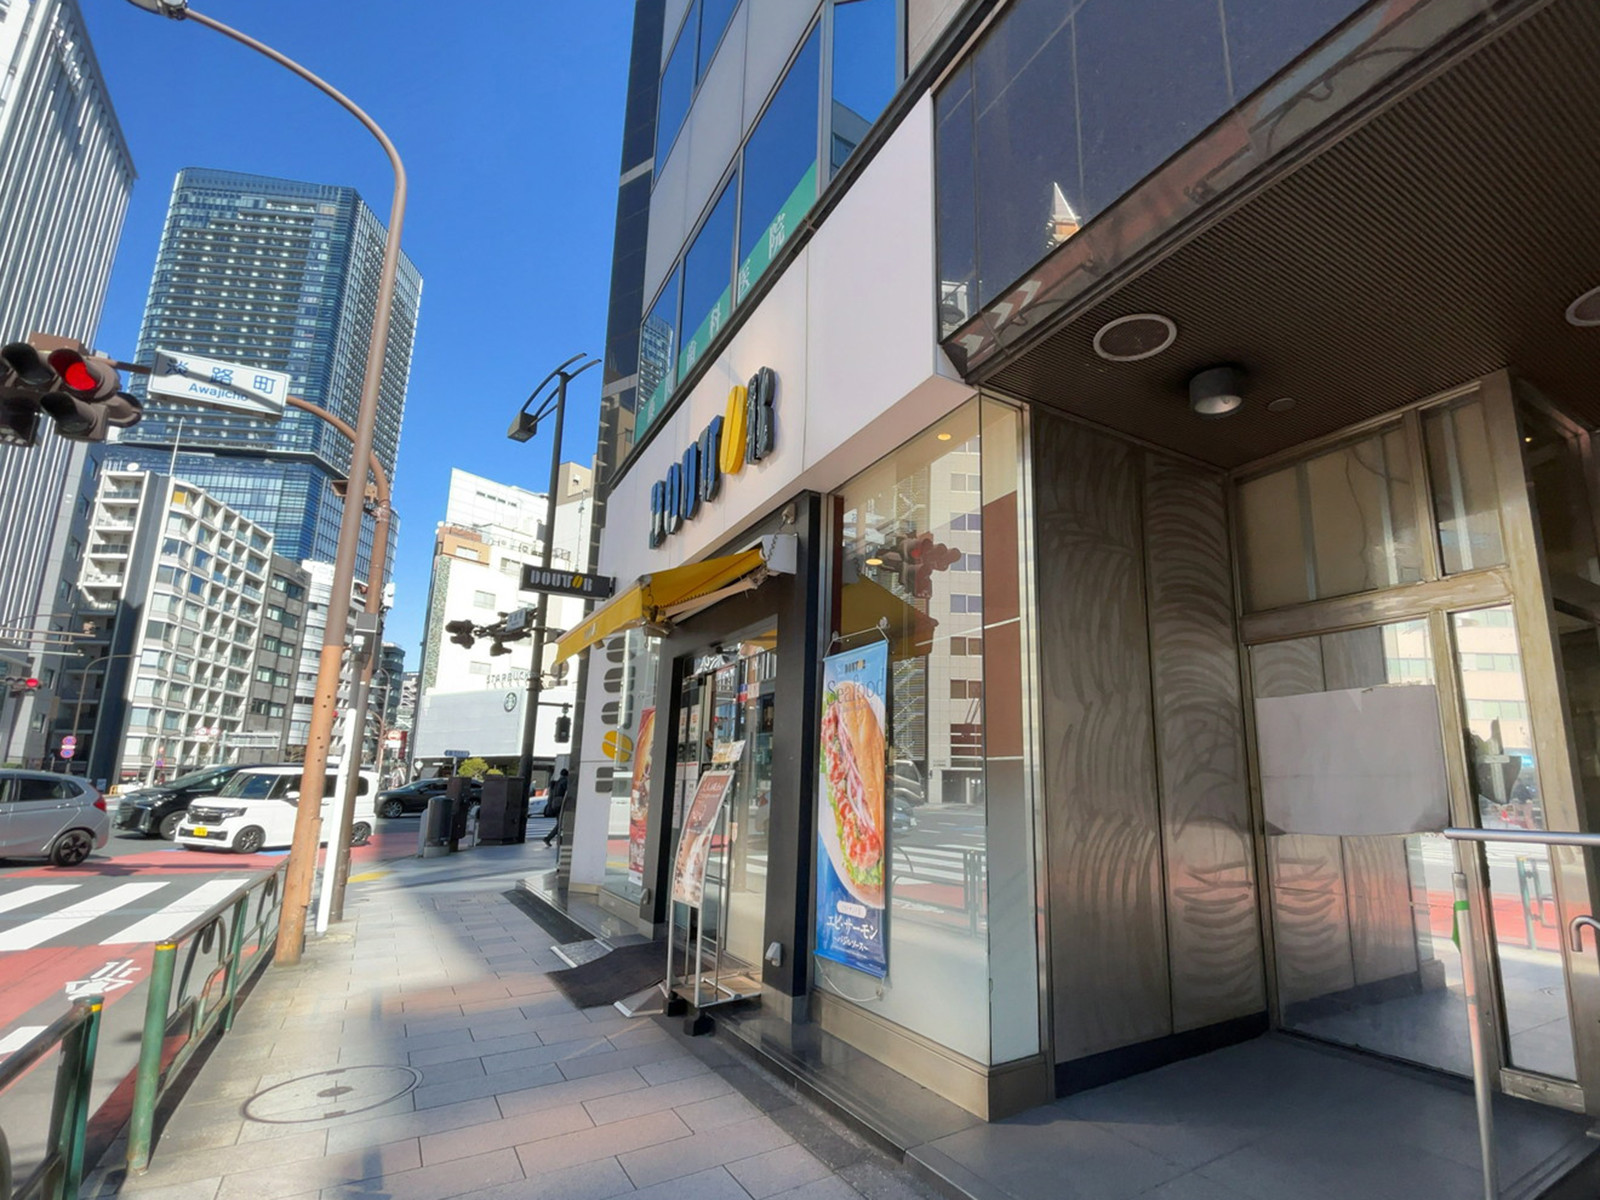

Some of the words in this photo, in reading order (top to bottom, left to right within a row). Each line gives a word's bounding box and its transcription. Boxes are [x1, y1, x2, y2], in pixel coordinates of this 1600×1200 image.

[165, 358, 277, 395] 淡路町
[188, 383, 248, 402] Awajicho
[649, 366, 776, 550] DOUTOR
[530, 569, 593, 592] DOUTOR
[486, 671, 532, 684] STARBUCK
[827, 667, 886, 706] Seafood
